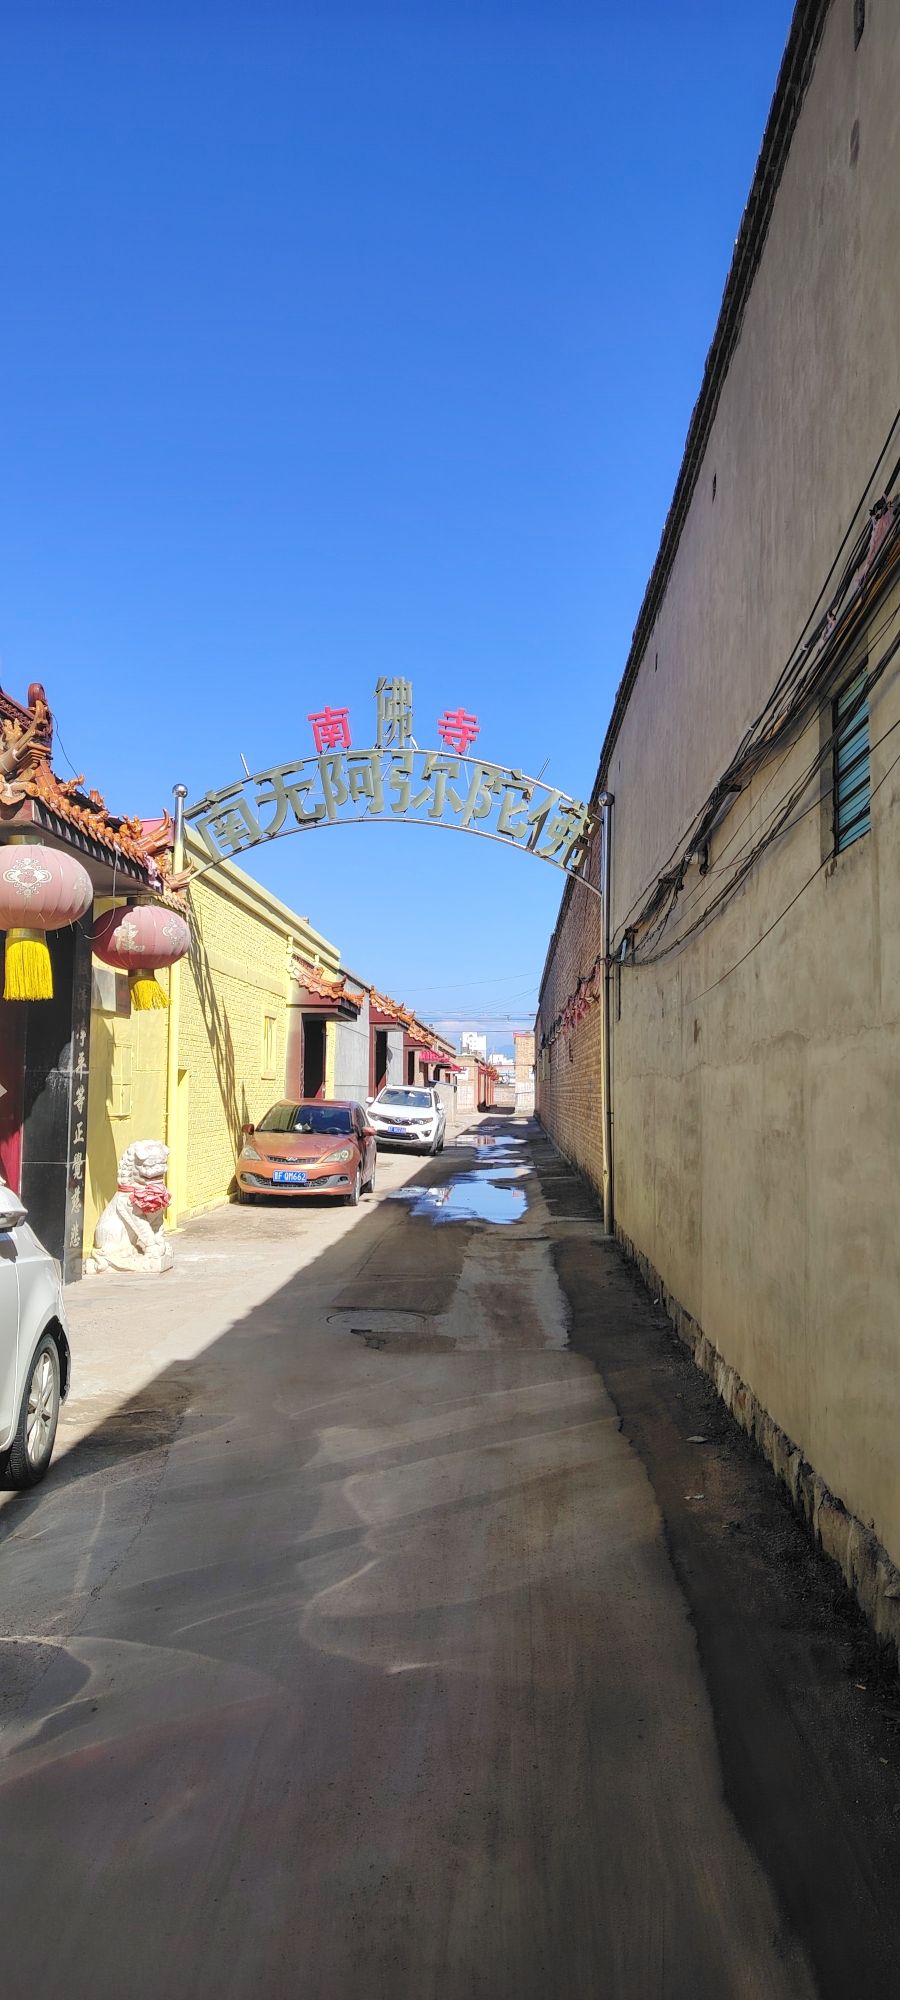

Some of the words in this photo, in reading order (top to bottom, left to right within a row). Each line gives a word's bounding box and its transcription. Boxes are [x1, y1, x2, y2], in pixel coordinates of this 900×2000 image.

[182, 748, 600, 868] 南无阿弥陀佛
